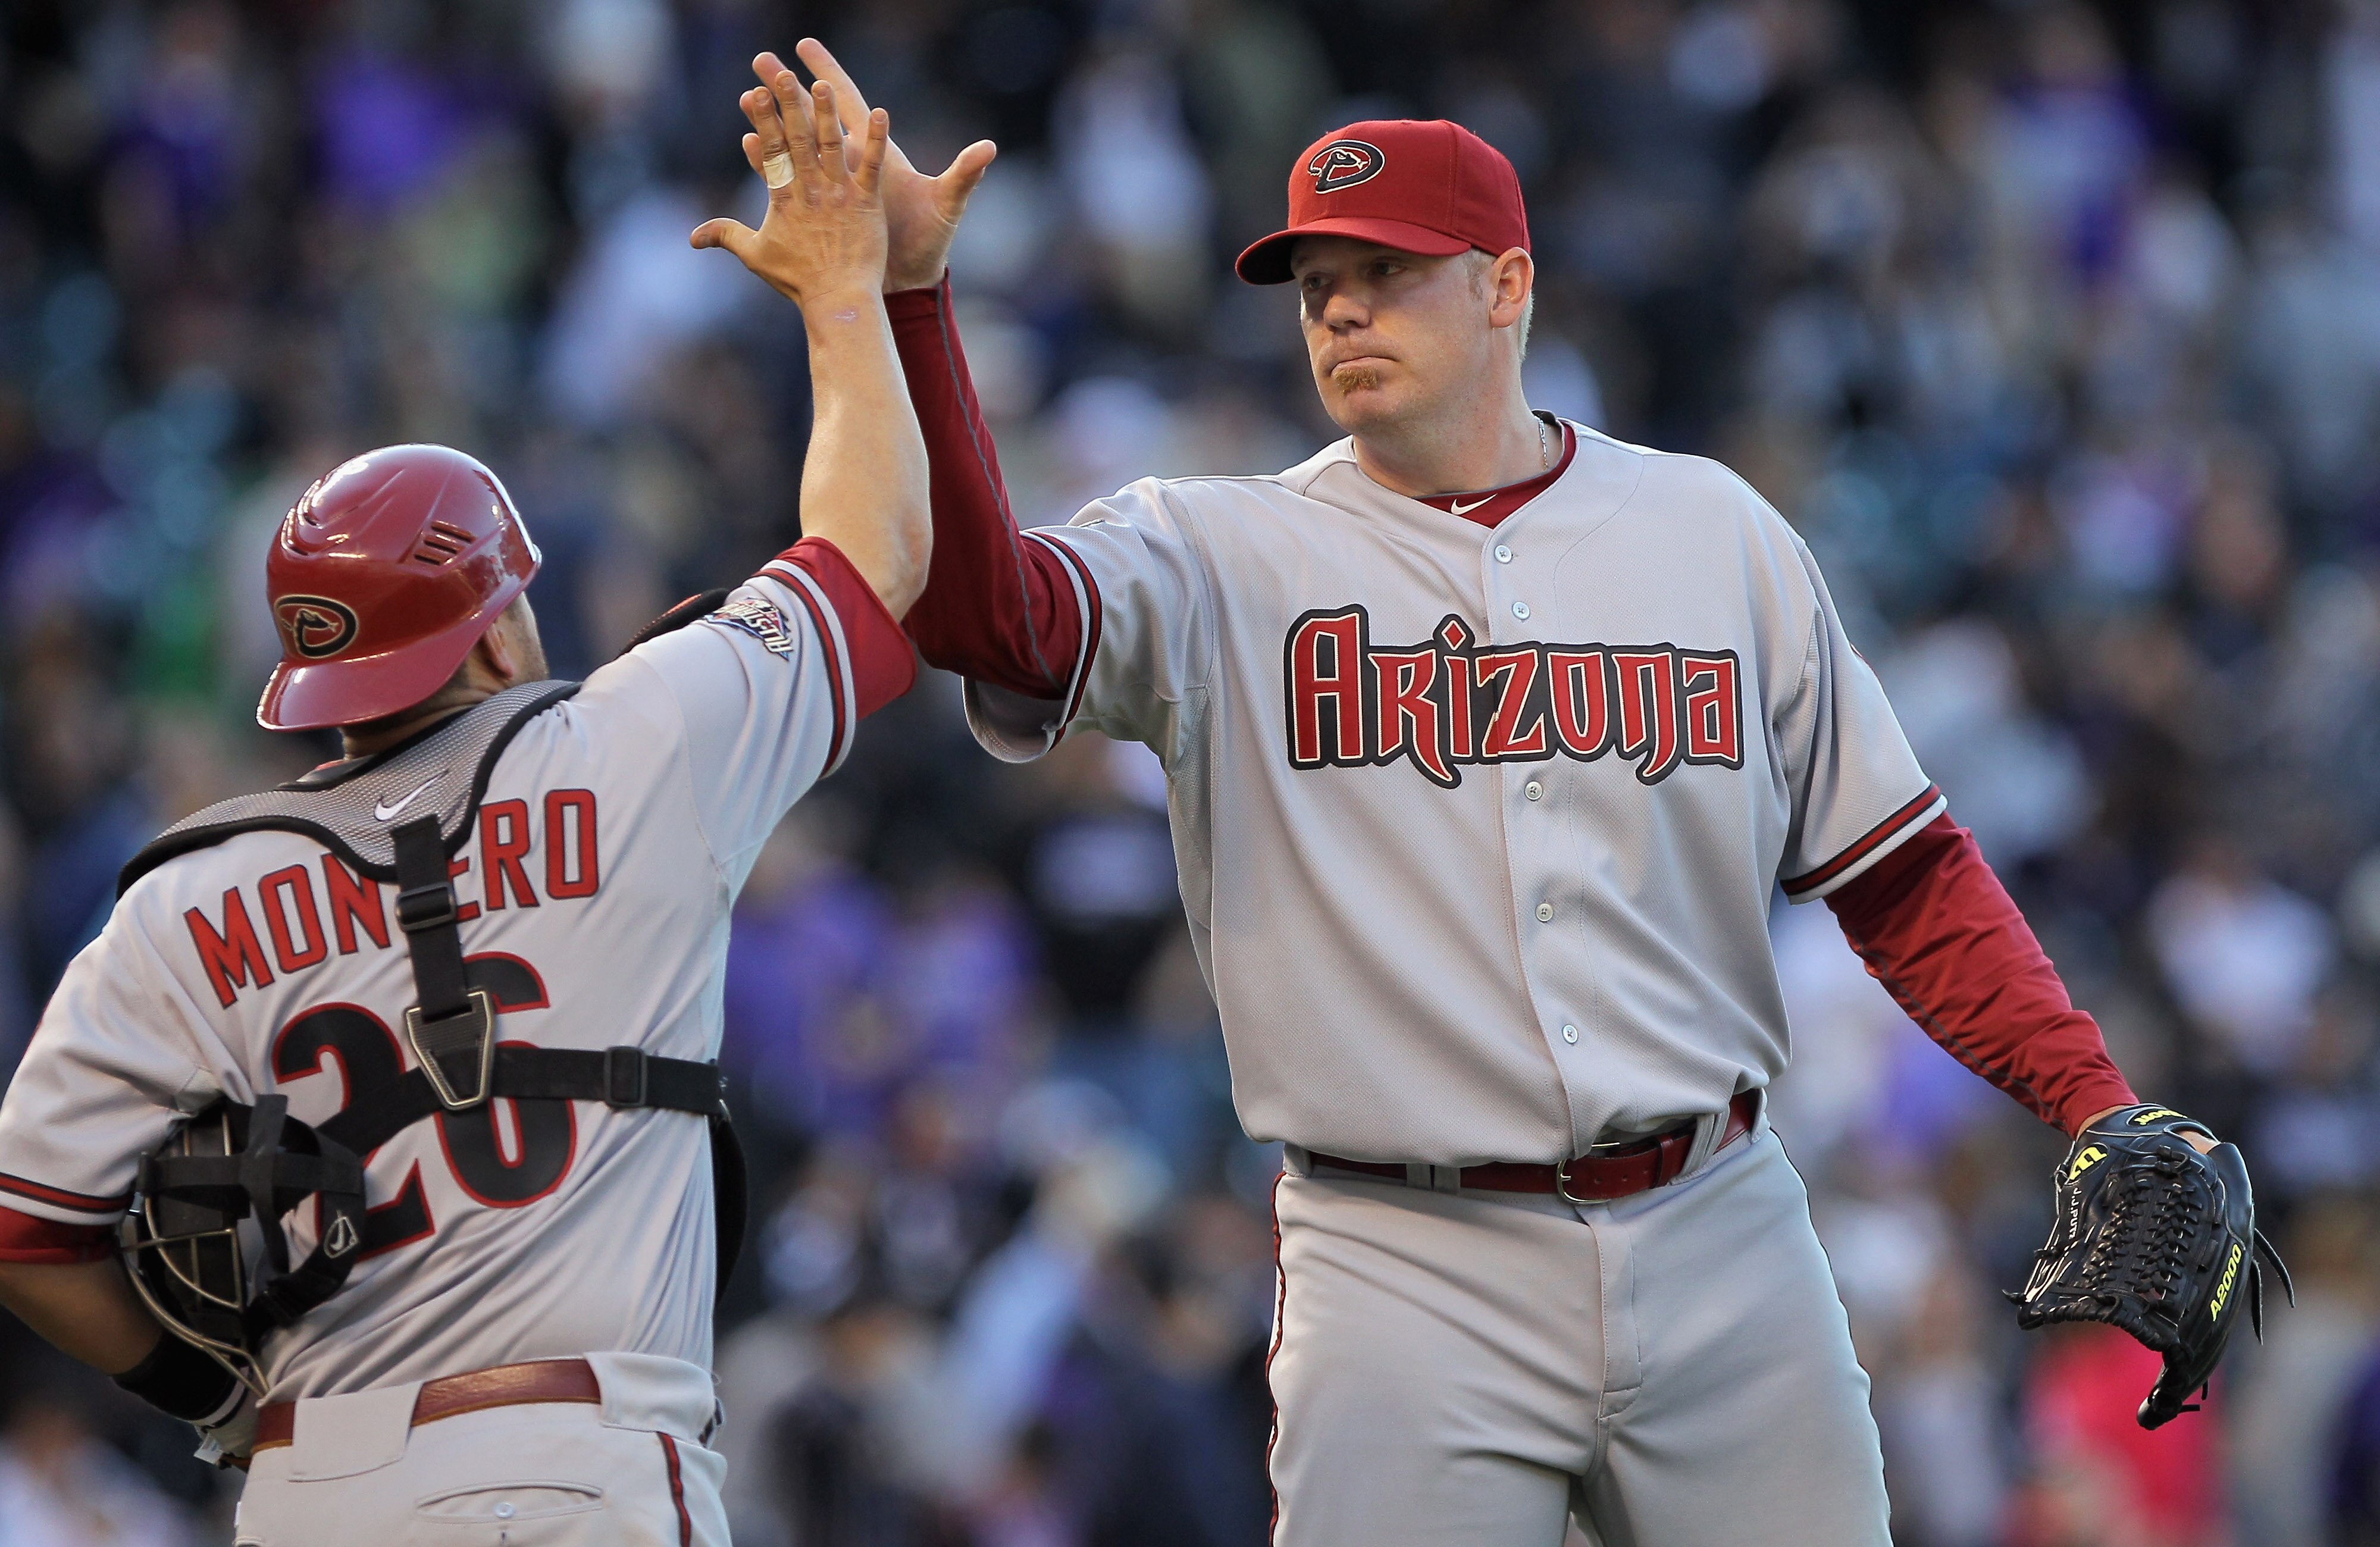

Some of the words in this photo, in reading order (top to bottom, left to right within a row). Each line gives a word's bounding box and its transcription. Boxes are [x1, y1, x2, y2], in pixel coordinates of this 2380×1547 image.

[184, 789, 599, 1009] MONERO
[271, 951, 577, 1261] 26
[2210, 1244, 2242, 1321] A2000
